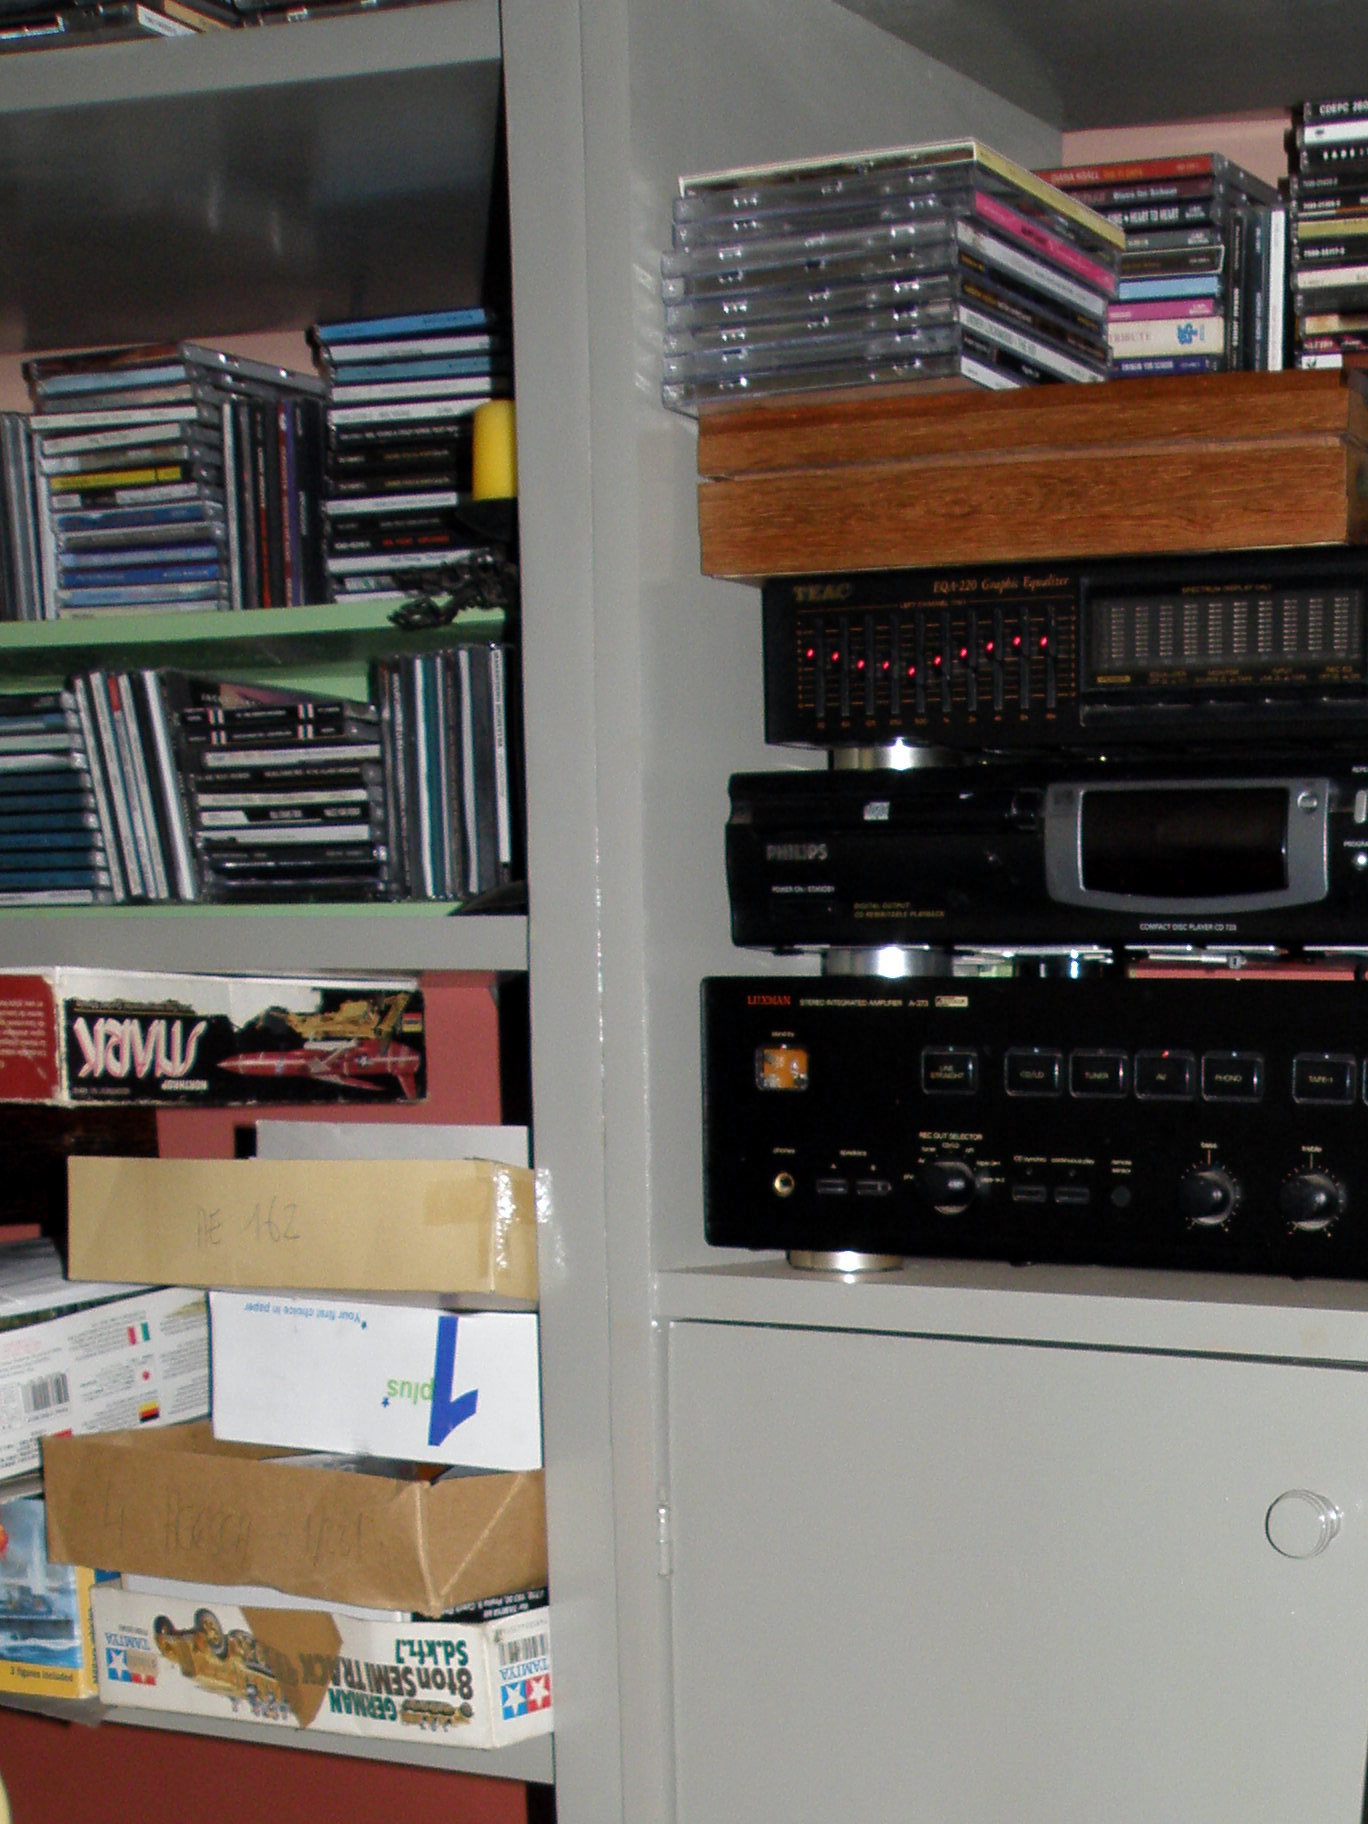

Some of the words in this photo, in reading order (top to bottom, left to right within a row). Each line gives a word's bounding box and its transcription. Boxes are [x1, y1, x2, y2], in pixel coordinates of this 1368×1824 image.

[981, 577, 1019, 592] Graphic
[1023, 575, 1070, 590] Equalizer
[1139, 923, 1171, 931] COMPACT
[1172, 923, 1187, 931] DISC
[747, 995, 791, 1006] LUXMAN
[283, 1306, 315, 1319] choice
[316, 1308, 335, 1322] first
[500, 1656, 549, 1681] TAMIYA
[367, 1663, 414, 1697] SEMI
[327, 1688, 398, 1722] GERMAN
